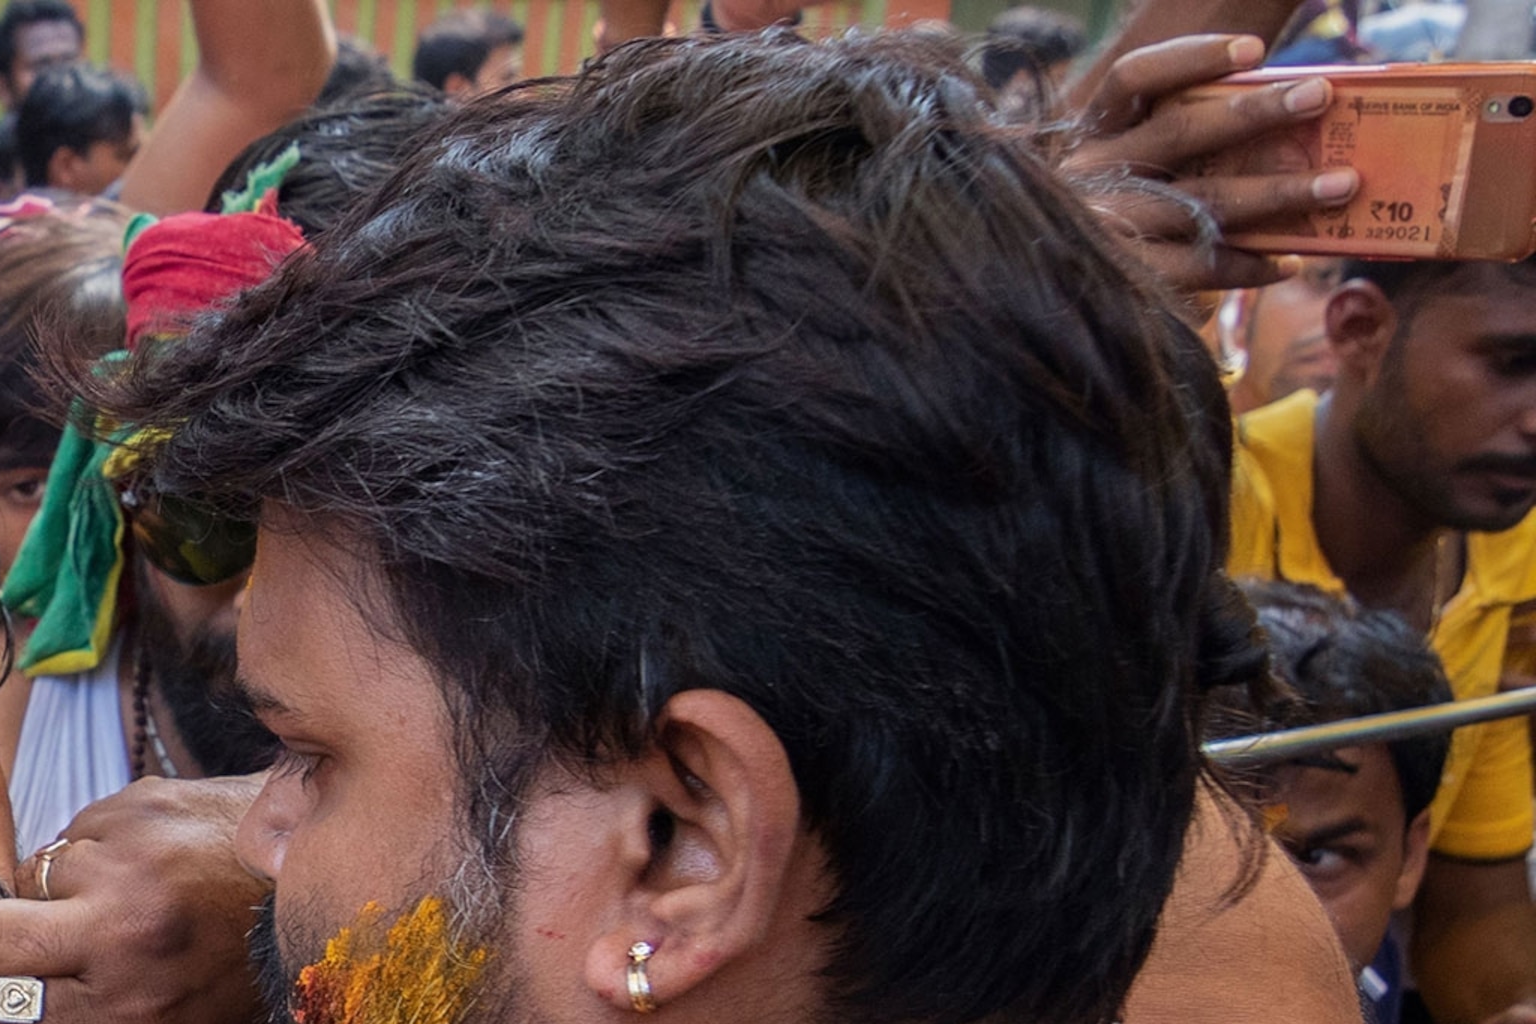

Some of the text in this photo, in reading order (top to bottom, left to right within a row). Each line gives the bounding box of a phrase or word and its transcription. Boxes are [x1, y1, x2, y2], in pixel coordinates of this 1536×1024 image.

[1391, 102, 1418, 111] BANK
[1420, 102, 1433, 111] OF
[1435, 102, 1462, 111] INDIA
[1370, 201, 1414, 222] ₹10
